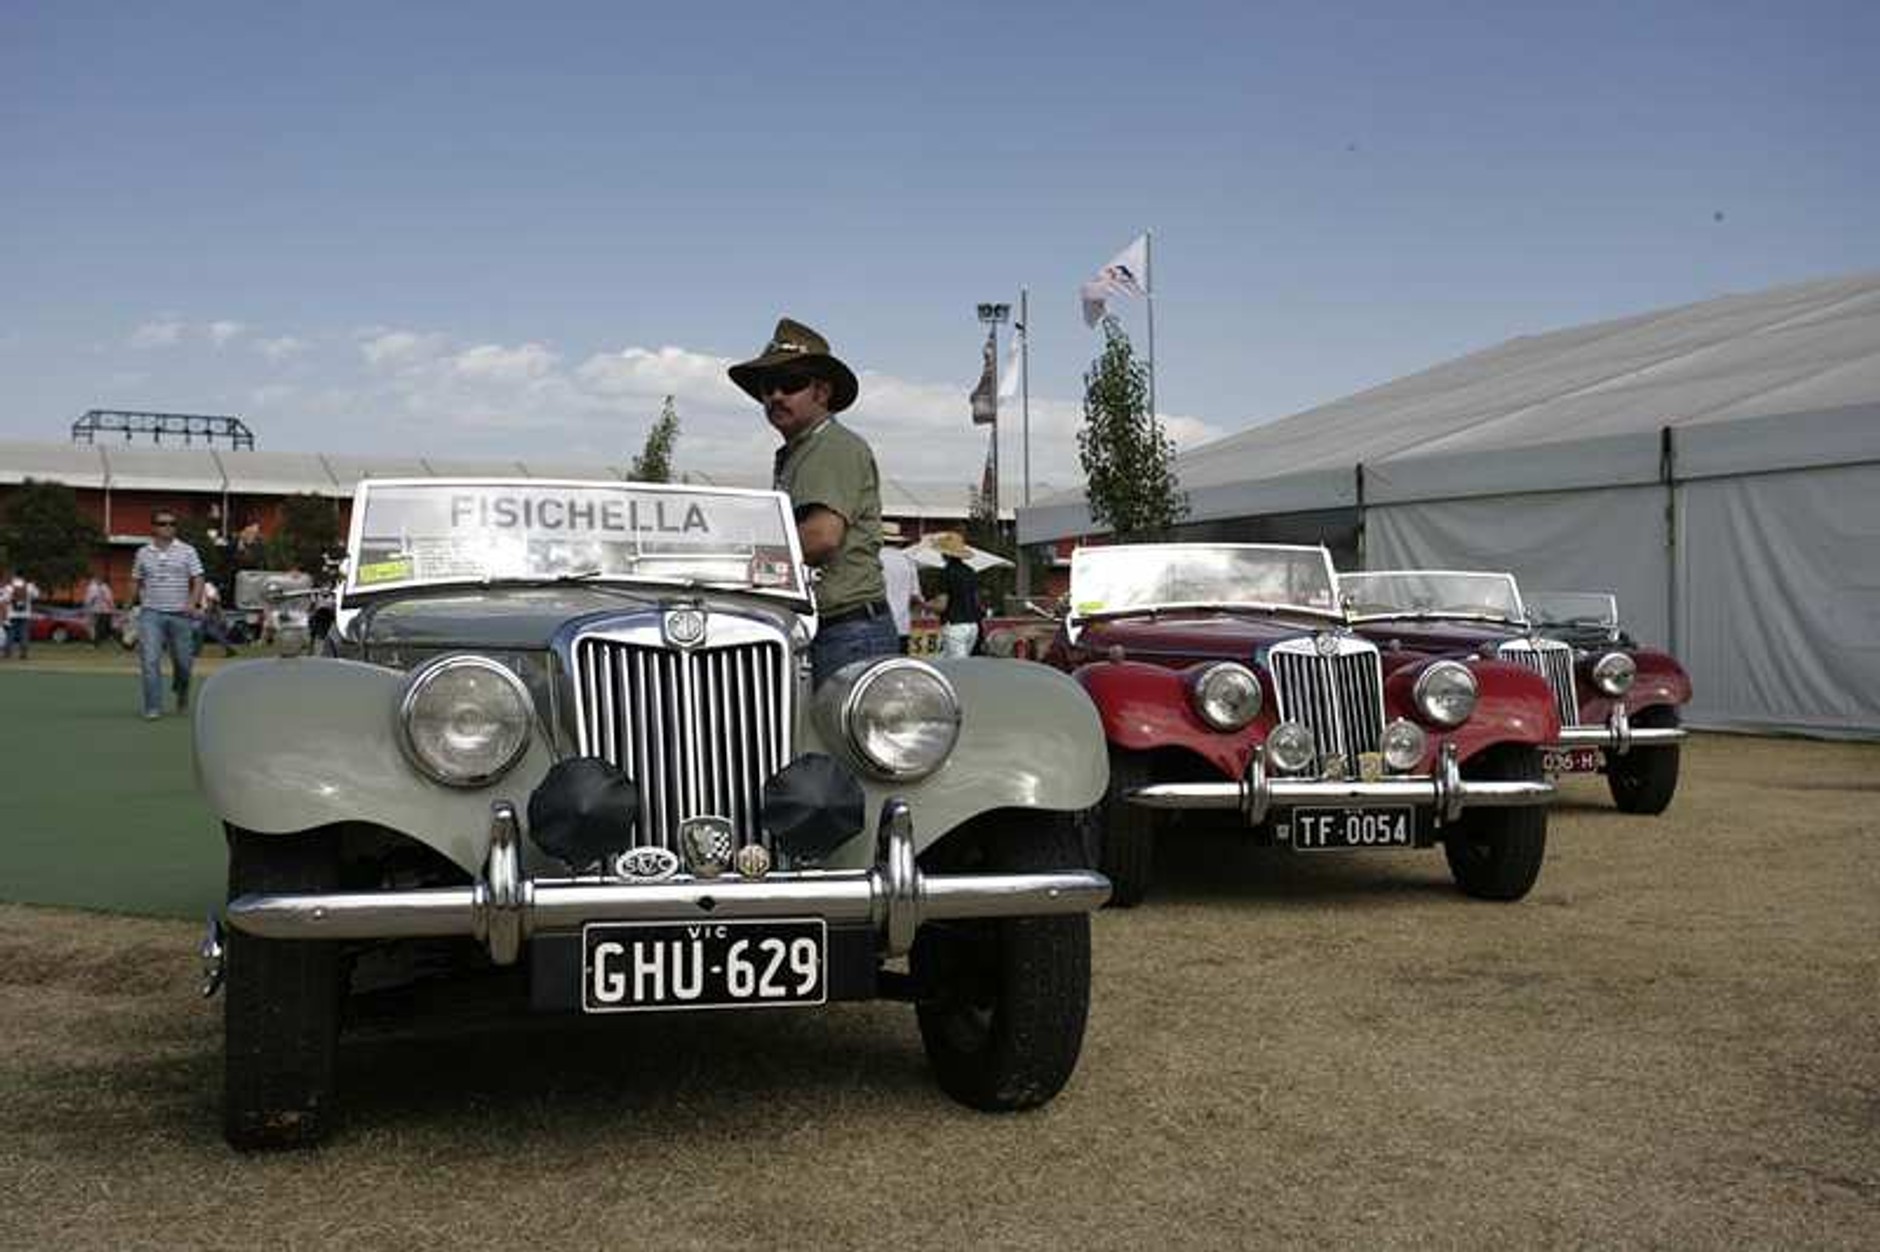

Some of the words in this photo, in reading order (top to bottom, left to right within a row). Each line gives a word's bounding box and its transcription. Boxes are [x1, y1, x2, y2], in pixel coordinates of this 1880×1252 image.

[450, 495, 709, 533] FISICHELLA
[687, 925, 728, 939] VIC
[594, 937, 818, 1002] GHU-629
